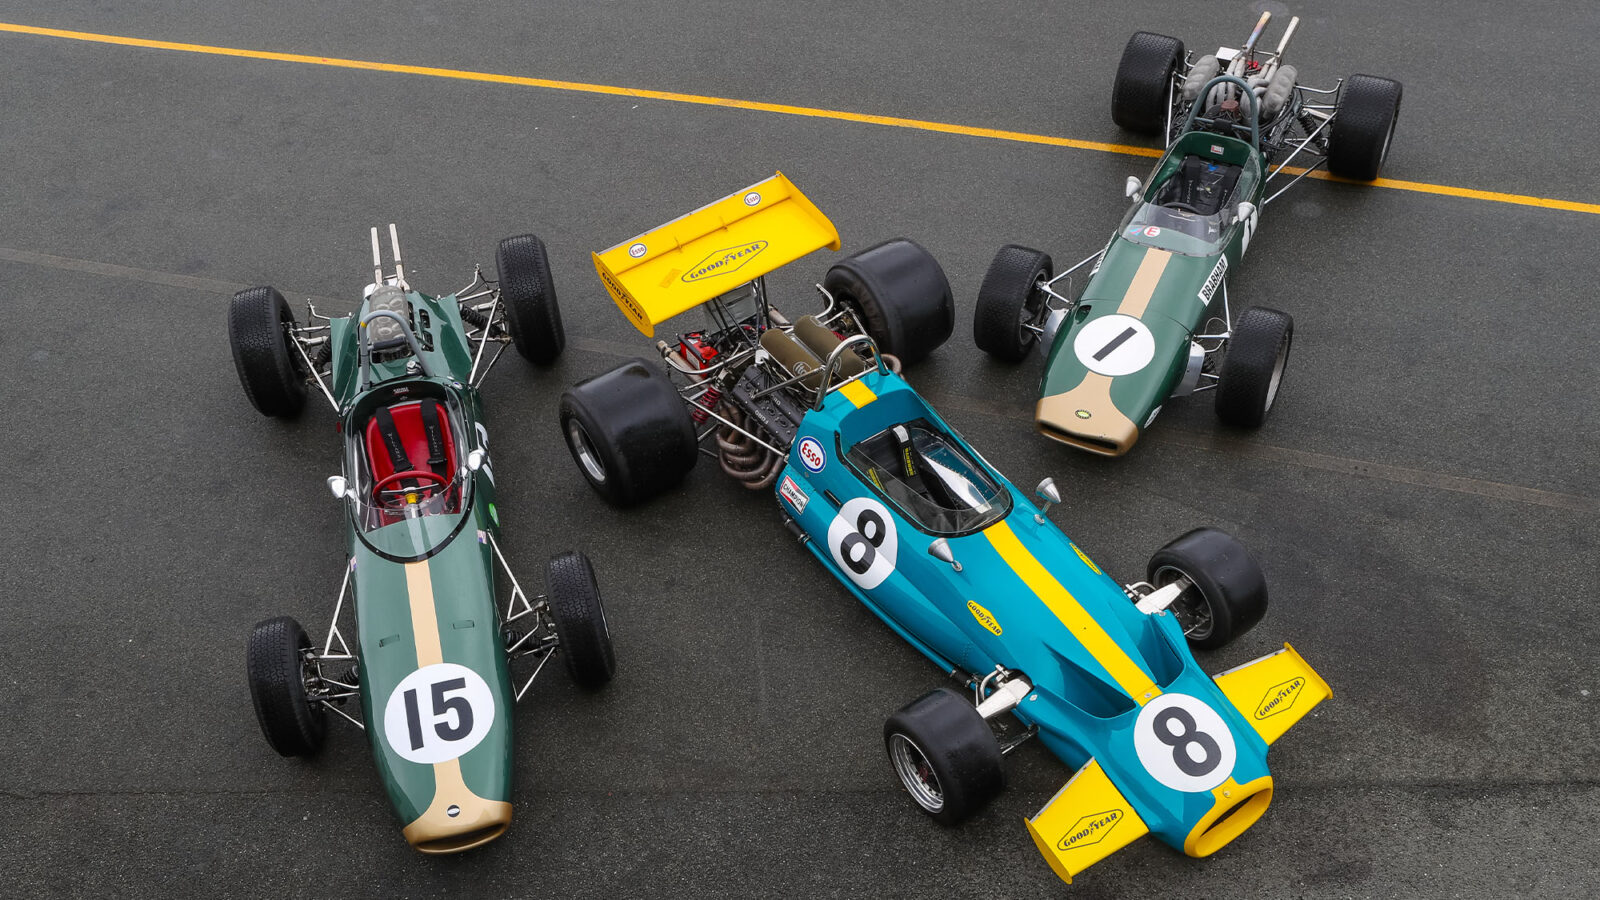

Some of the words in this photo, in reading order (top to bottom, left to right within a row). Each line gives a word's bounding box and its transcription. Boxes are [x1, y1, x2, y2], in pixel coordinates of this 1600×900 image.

[1146, 227, 1159, 236] E
[1201, 258, 1226, 301] BRABHAM
[1092, 326, 1138, 362] 1
[783, 483, 804, 507] CHAMPION
[840, 509, 886, 575] 8
[403, 677, 474, 751] 15
[1153, 706, 1221, 777] 8
